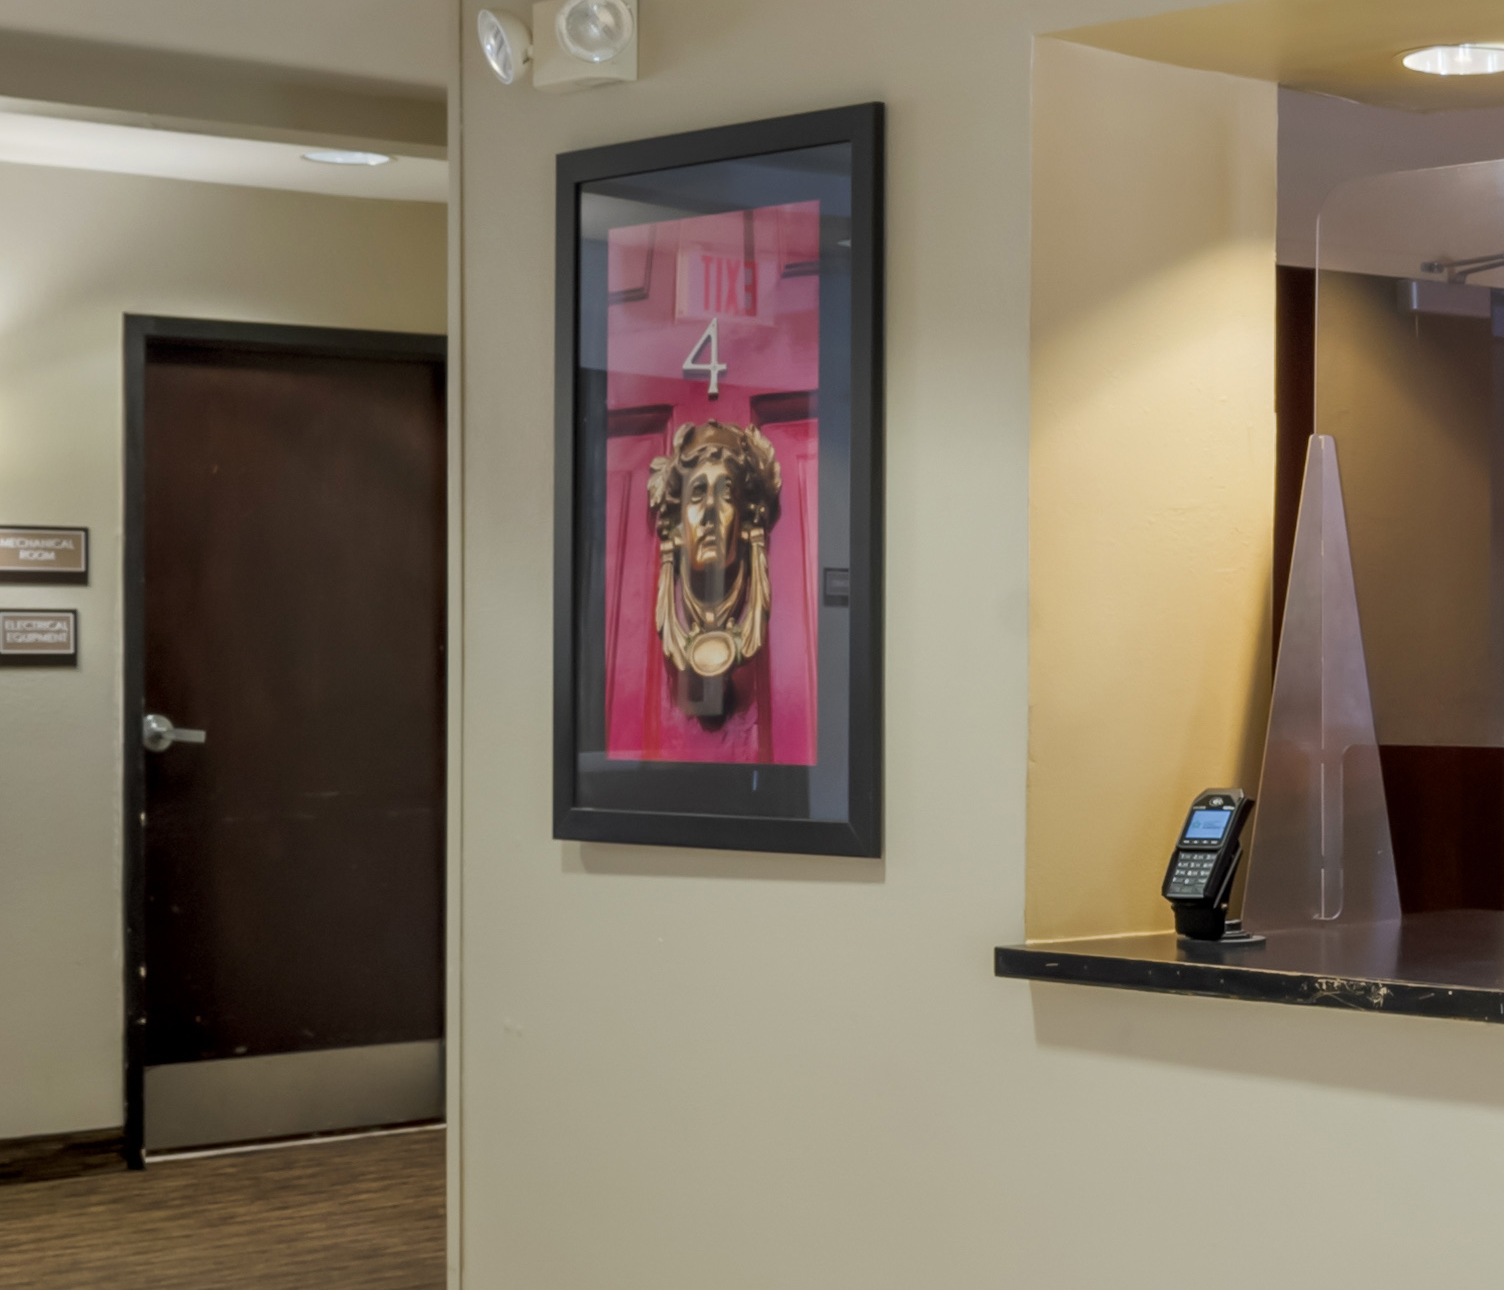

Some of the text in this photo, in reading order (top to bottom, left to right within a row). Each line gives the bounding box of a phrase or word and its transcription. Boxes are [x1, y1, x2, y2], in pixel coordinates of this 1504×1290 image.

[682, 317, 727, 395] 4
[0, 537, 75, 549] MECHANICAL
[18, 549, 56, 560] ROOM
[4, 620, 69, 631] ELECTRICAL
[6, 632, 68, 643] EQUIPMENT
